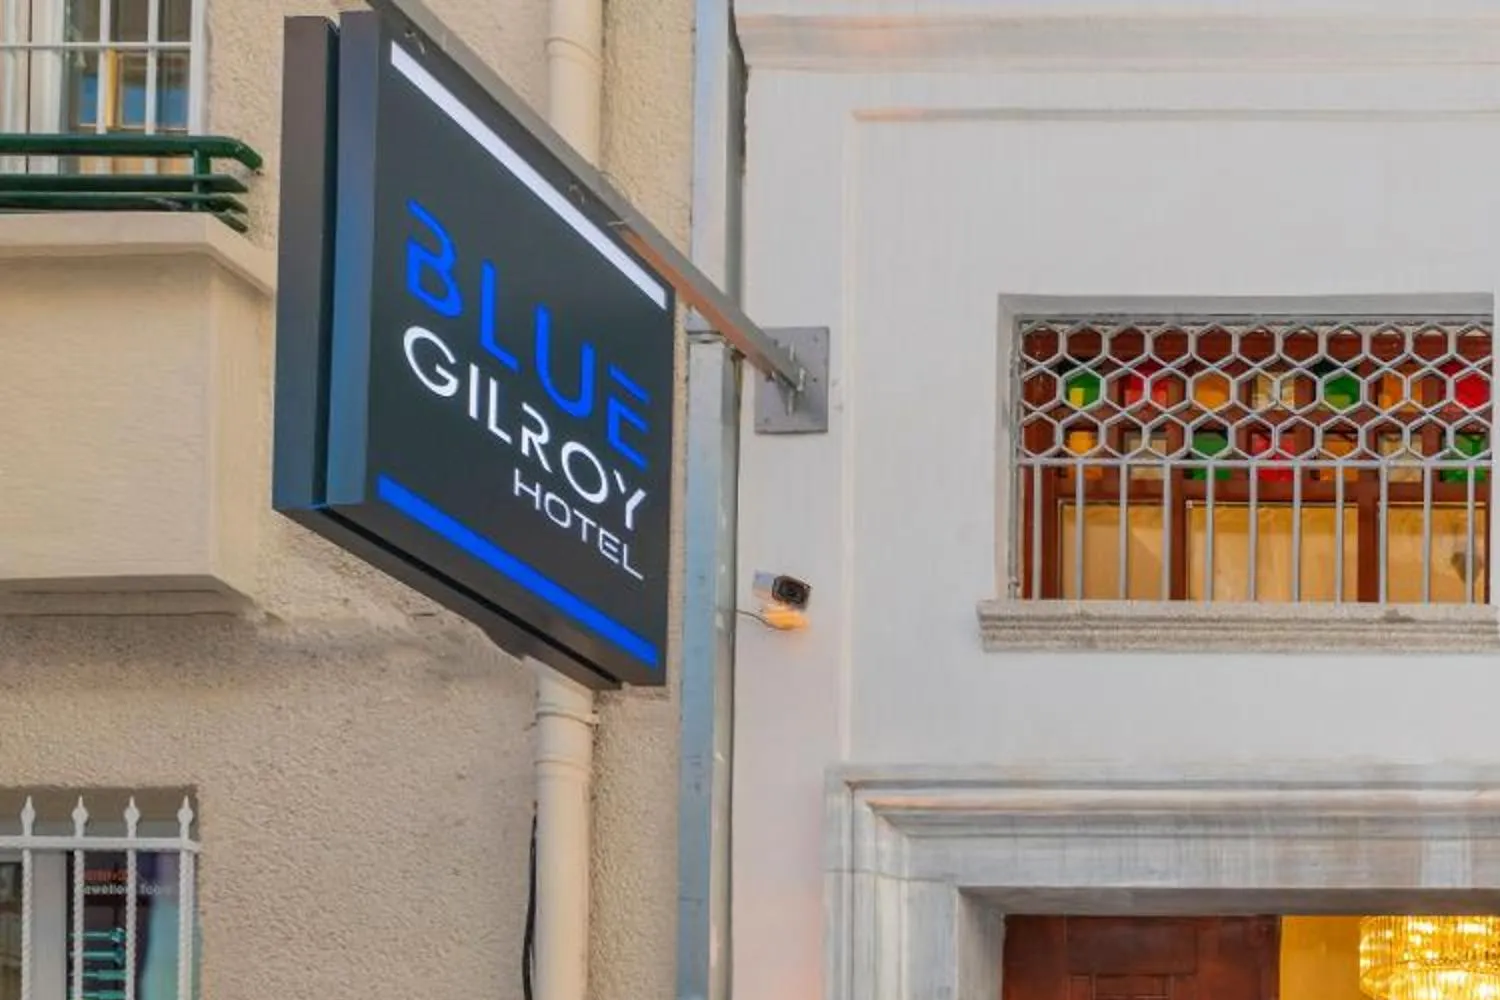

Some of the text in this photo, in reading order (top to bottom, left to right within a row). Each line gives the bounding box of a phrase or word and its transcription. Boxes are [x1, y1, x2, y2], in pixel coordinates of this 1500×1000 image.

[403, 325, 646, 531] GILROY
[406, 199, 649, 470] BLUE
[513, 467, 645, 580] HOTEL
